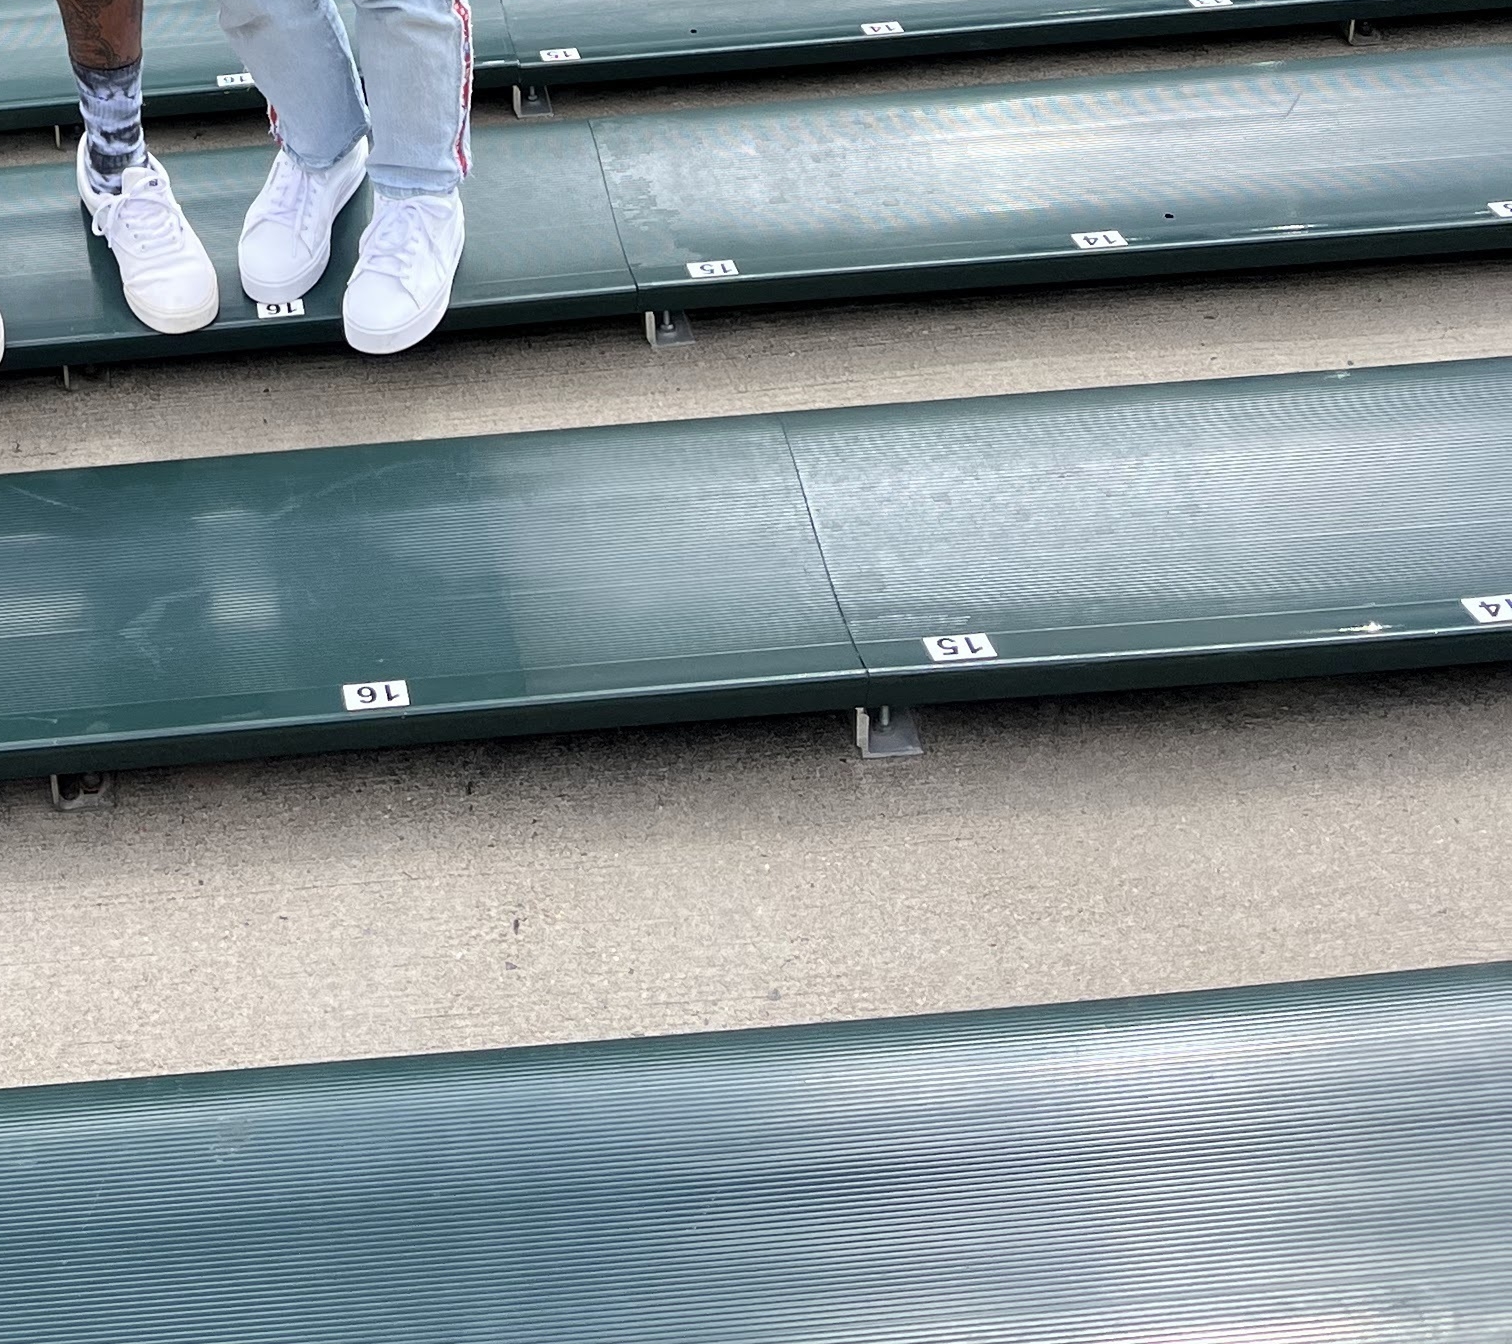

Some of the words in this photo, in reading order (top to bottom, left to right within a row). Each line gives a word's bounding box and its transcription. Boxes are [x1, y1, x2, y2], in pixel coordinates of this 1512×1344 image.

[870, 25, 896, 33] 14
[547, 50, 571, 59] 15
[1082, 234, 1117, 245] 14
[700, 263, 732, 274] 15
[266, 302, 297, 314] 16
[936, 636, 982, 655] 15
[357, 684, 400, 704] 16
